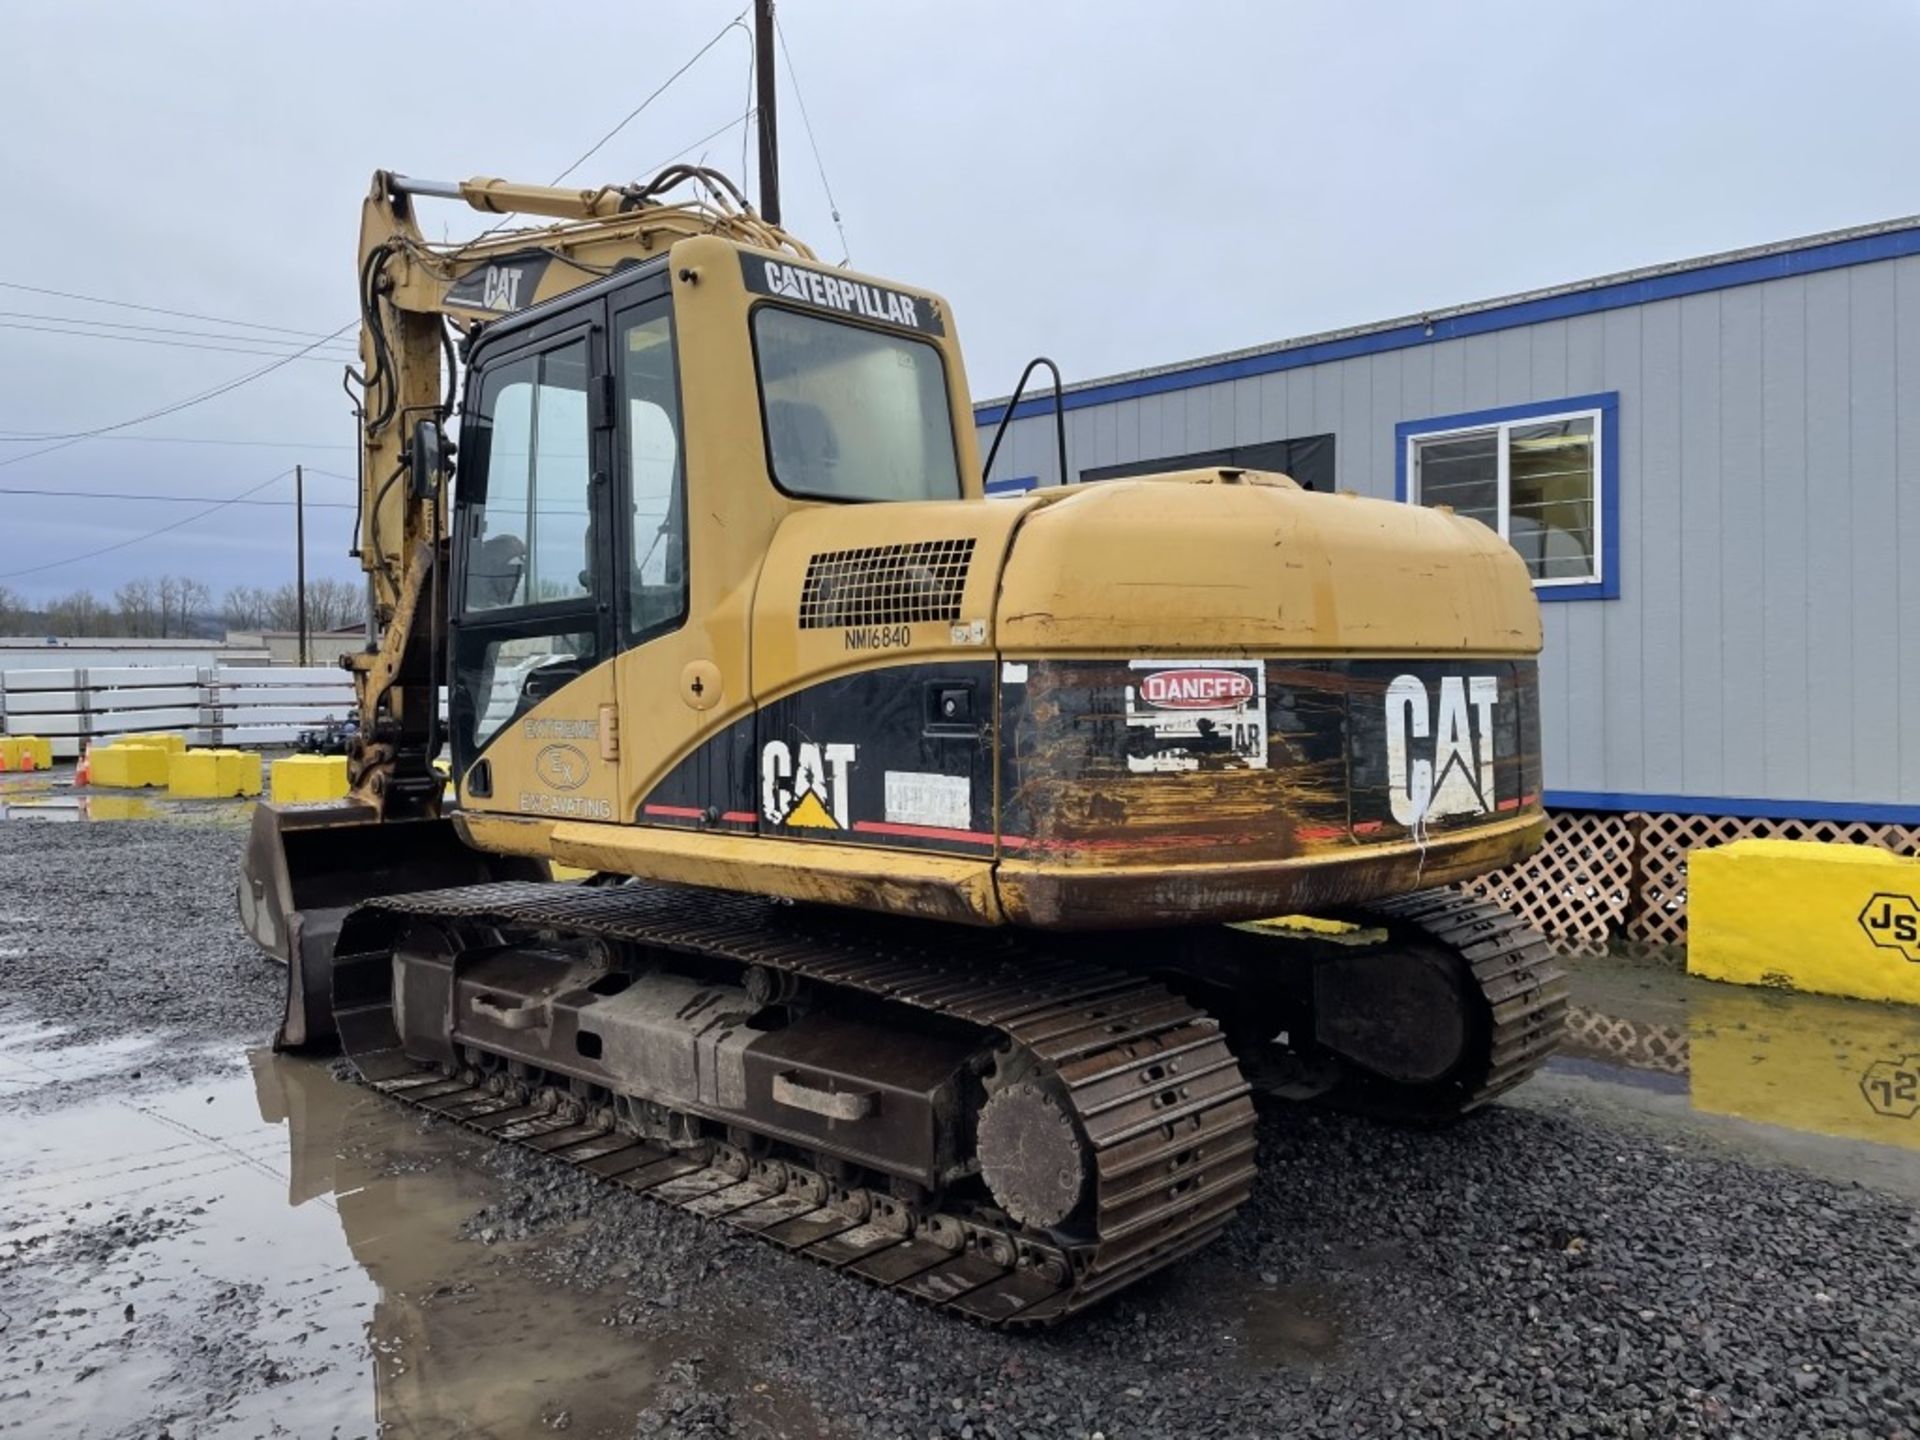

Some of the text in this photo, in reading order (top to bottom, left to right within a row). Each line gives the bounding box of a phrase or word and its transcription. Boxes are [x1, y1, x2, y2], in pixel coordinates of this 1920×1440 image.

[484, 265, 523, 311] CAT
[764, 261, 919, 327] CATERPILLAR
[1149, 678, 1246, 700] DANGER
[1385, 674, 1499, 826] CAT
[519, 795, 612, 818] EXCAVATING
[762, 740, 856, 830] CAT
[1870, 903, 1920, 949] JS
